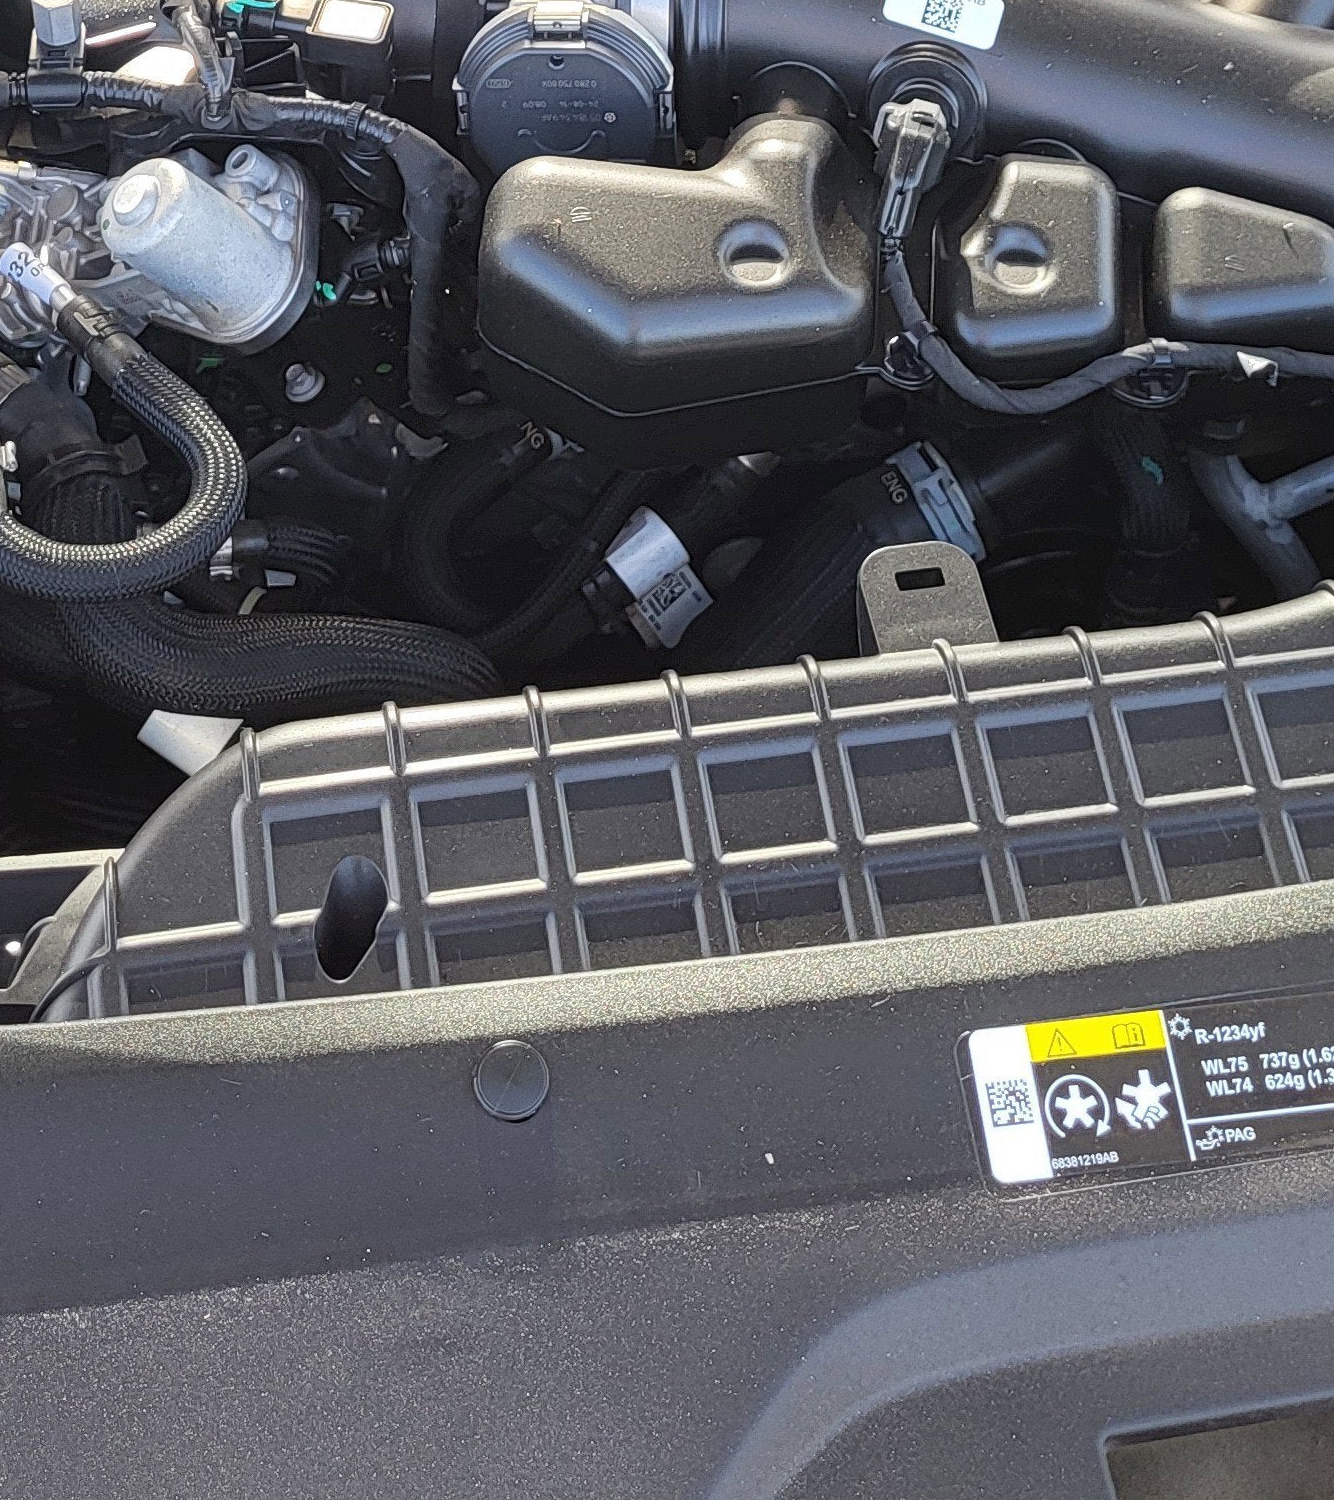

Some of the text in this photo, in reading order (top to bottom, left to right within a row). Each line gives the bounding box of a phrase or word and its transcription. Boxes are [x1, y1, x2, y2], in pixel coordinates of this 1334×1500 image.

[879, 469, 908, 503] ENG
[1194, 1021, 1266, 1045] R-1234yf
[1201, 1056, 1249, 1076] WL75
[1259, 1051, 1301, 1071] 737g
[1205, 1077, 1254, 1098] WL74
[1264, 1071, 1305, 1092] 624g
[1224, 1126, 1257, 1144] PAG
[1051, 1150, 1120, 1170] 68381219AB
